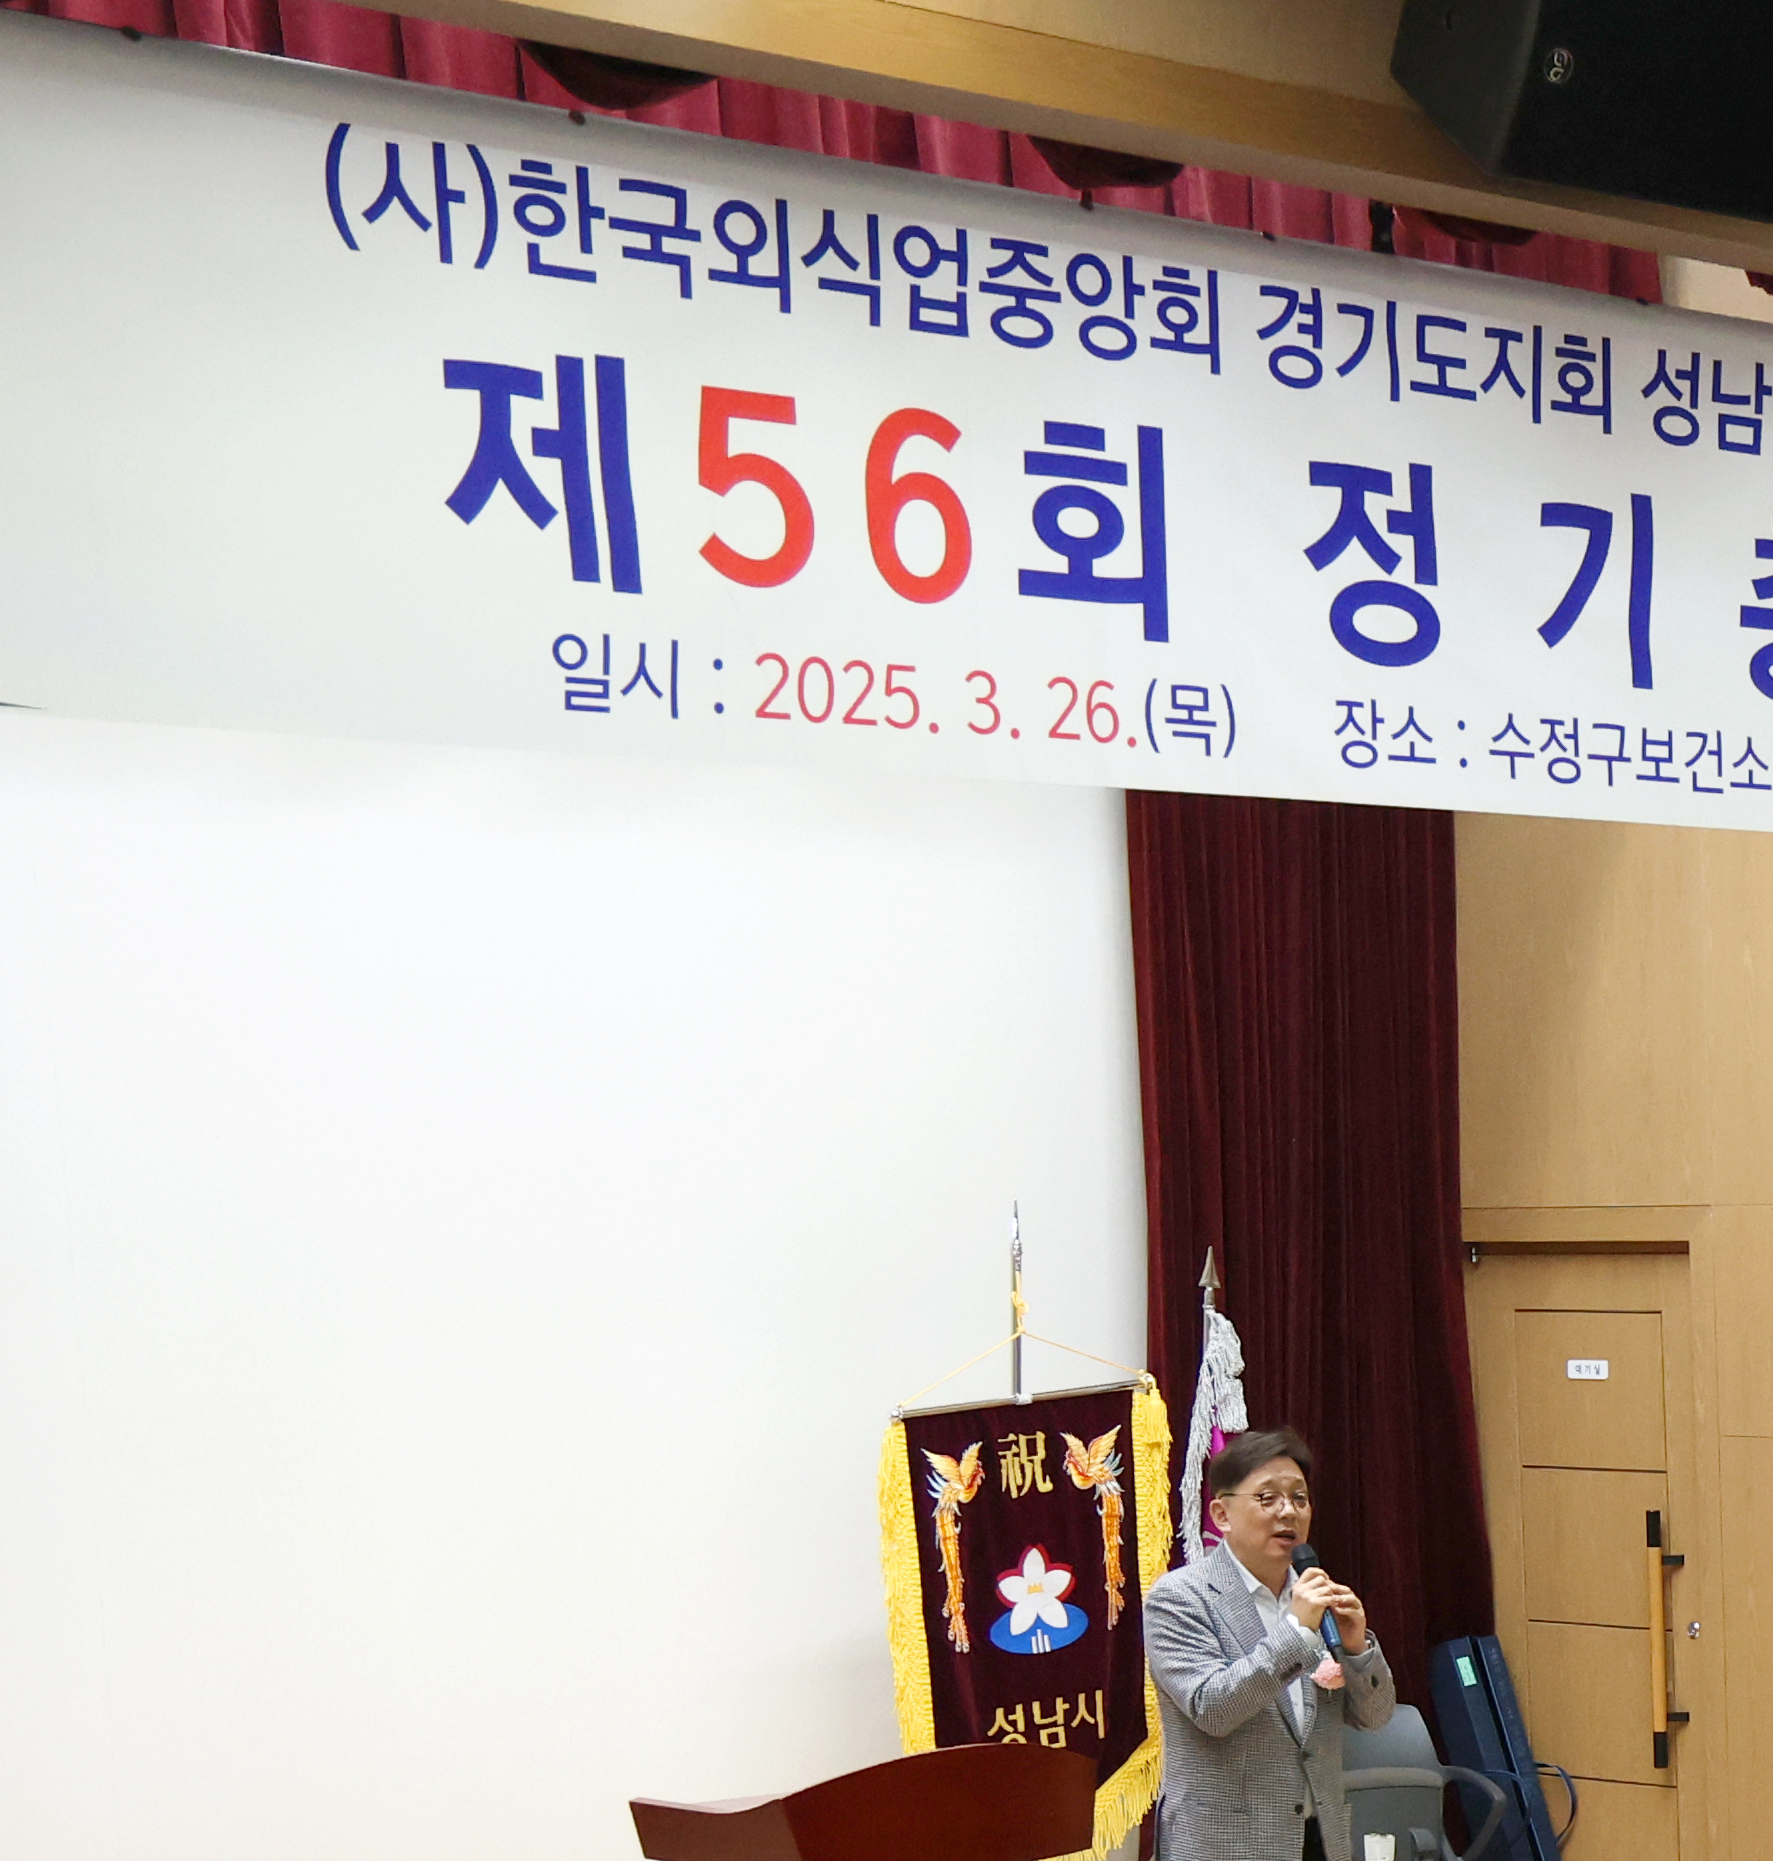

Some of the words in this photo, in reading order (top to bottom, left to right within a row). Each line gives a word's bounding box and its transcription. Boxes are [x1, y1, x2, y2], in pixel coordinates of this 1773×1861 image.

[326, 123, 1222, 376] (사)한국외식업중앙회
[1257, 284, 1613, 433] 경기도지회
[443, 354, 1170, 643] 제56회
[551, 634, 680, 719] 일시
[754, 651, 940, 735] 2025.
[965, 669, 1021, 740] 3.
[1334, 699, 1439, 770] 장소
[1489, 713, 1773, 795] 수정구보건소
[997, 1430, 1054, 1500] 祝
[986, 1689, 1106, 1749] 성남시
